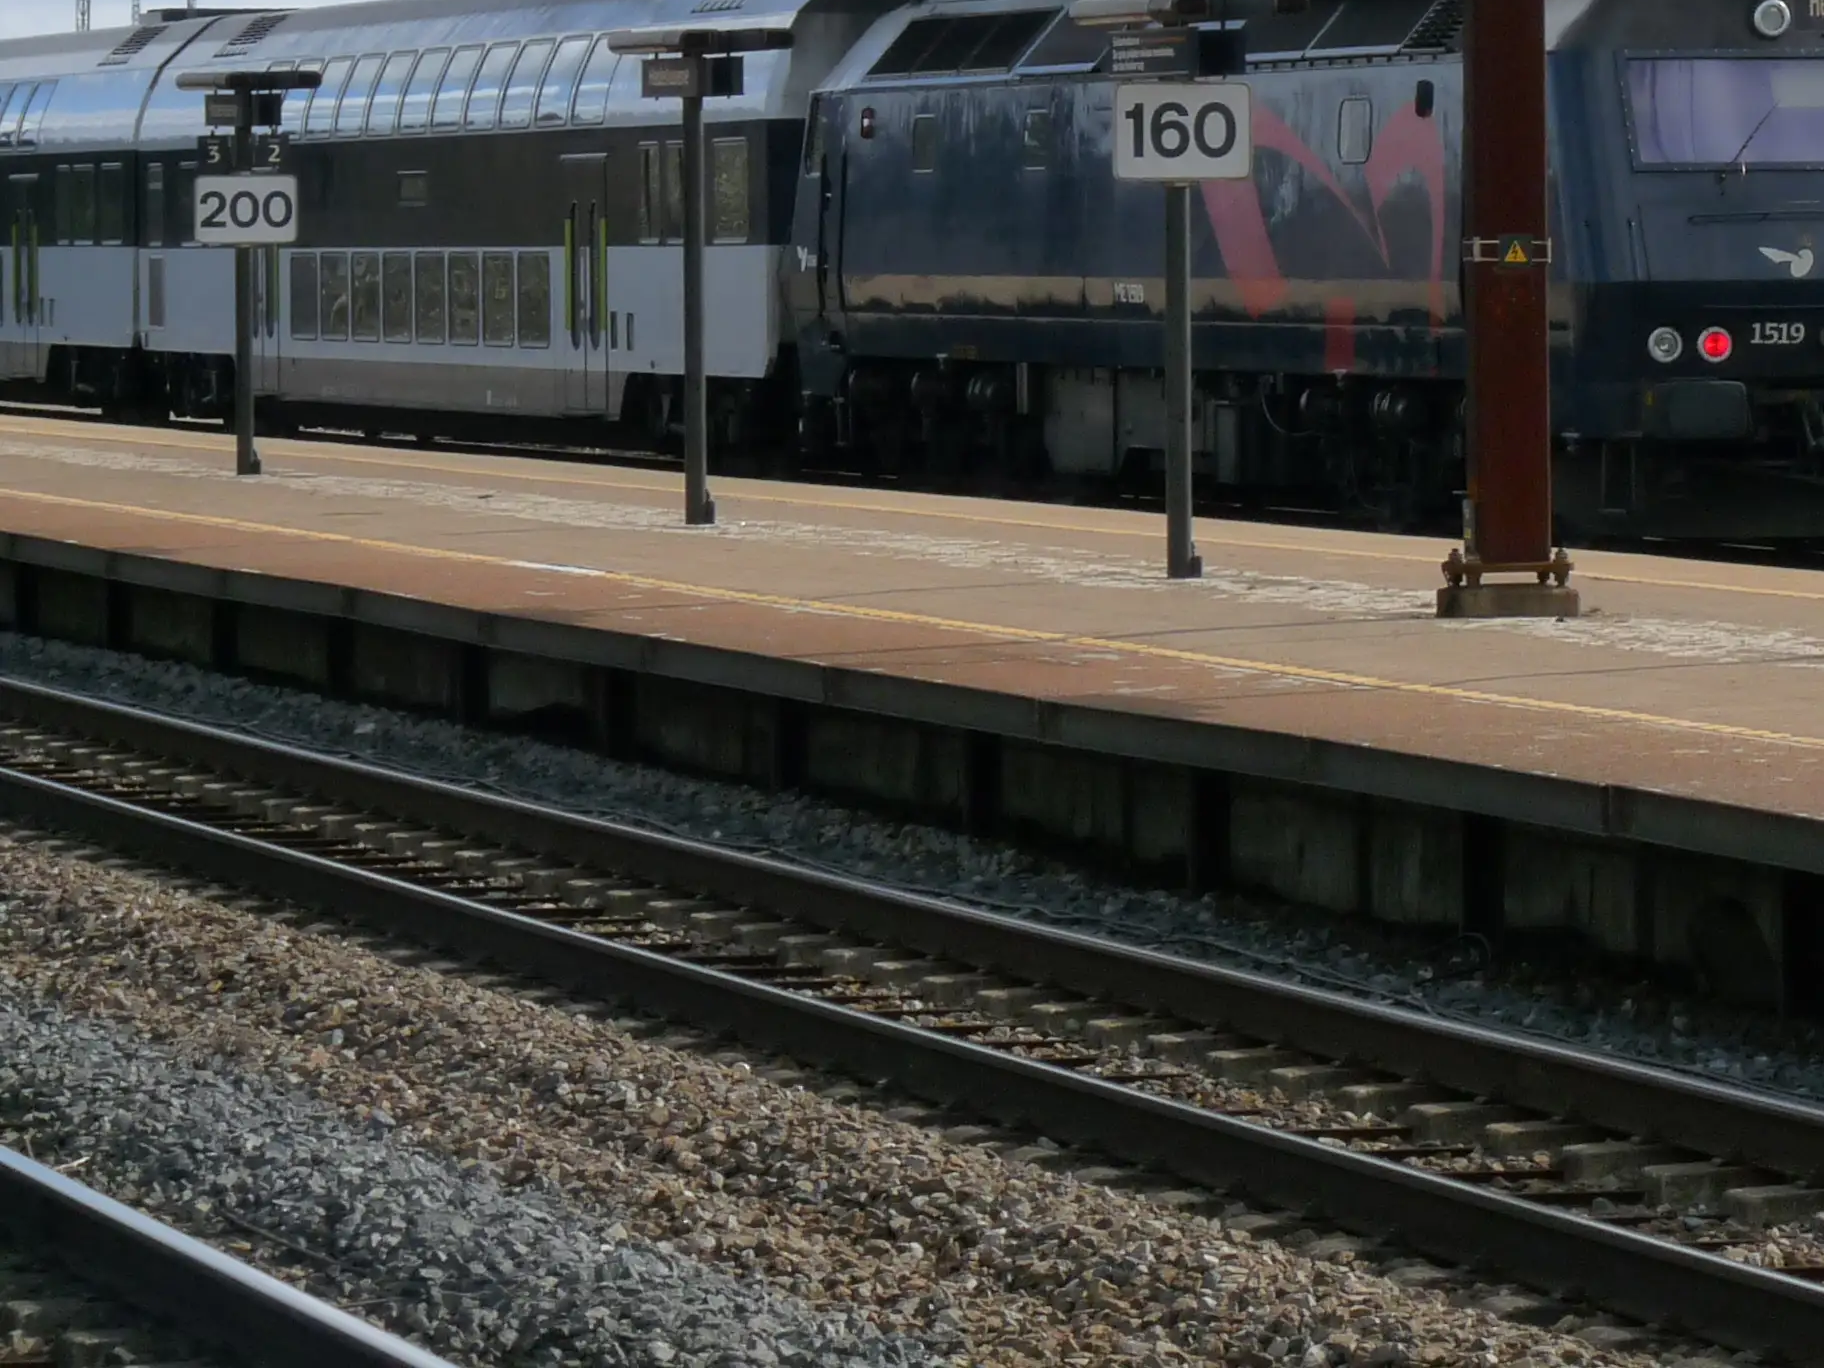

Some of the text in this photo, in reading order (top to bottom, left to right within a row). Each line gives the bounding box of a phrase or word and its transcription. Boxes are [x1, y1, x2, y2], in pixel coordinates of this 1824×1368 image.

[1125, 101, 1237, 159] 160
[207, 145, 221, 164] 3
[267, 144, 281, 162] 2
[200, 190, 293, 228] 200
[1750, 322, 1805, 344] 1519
